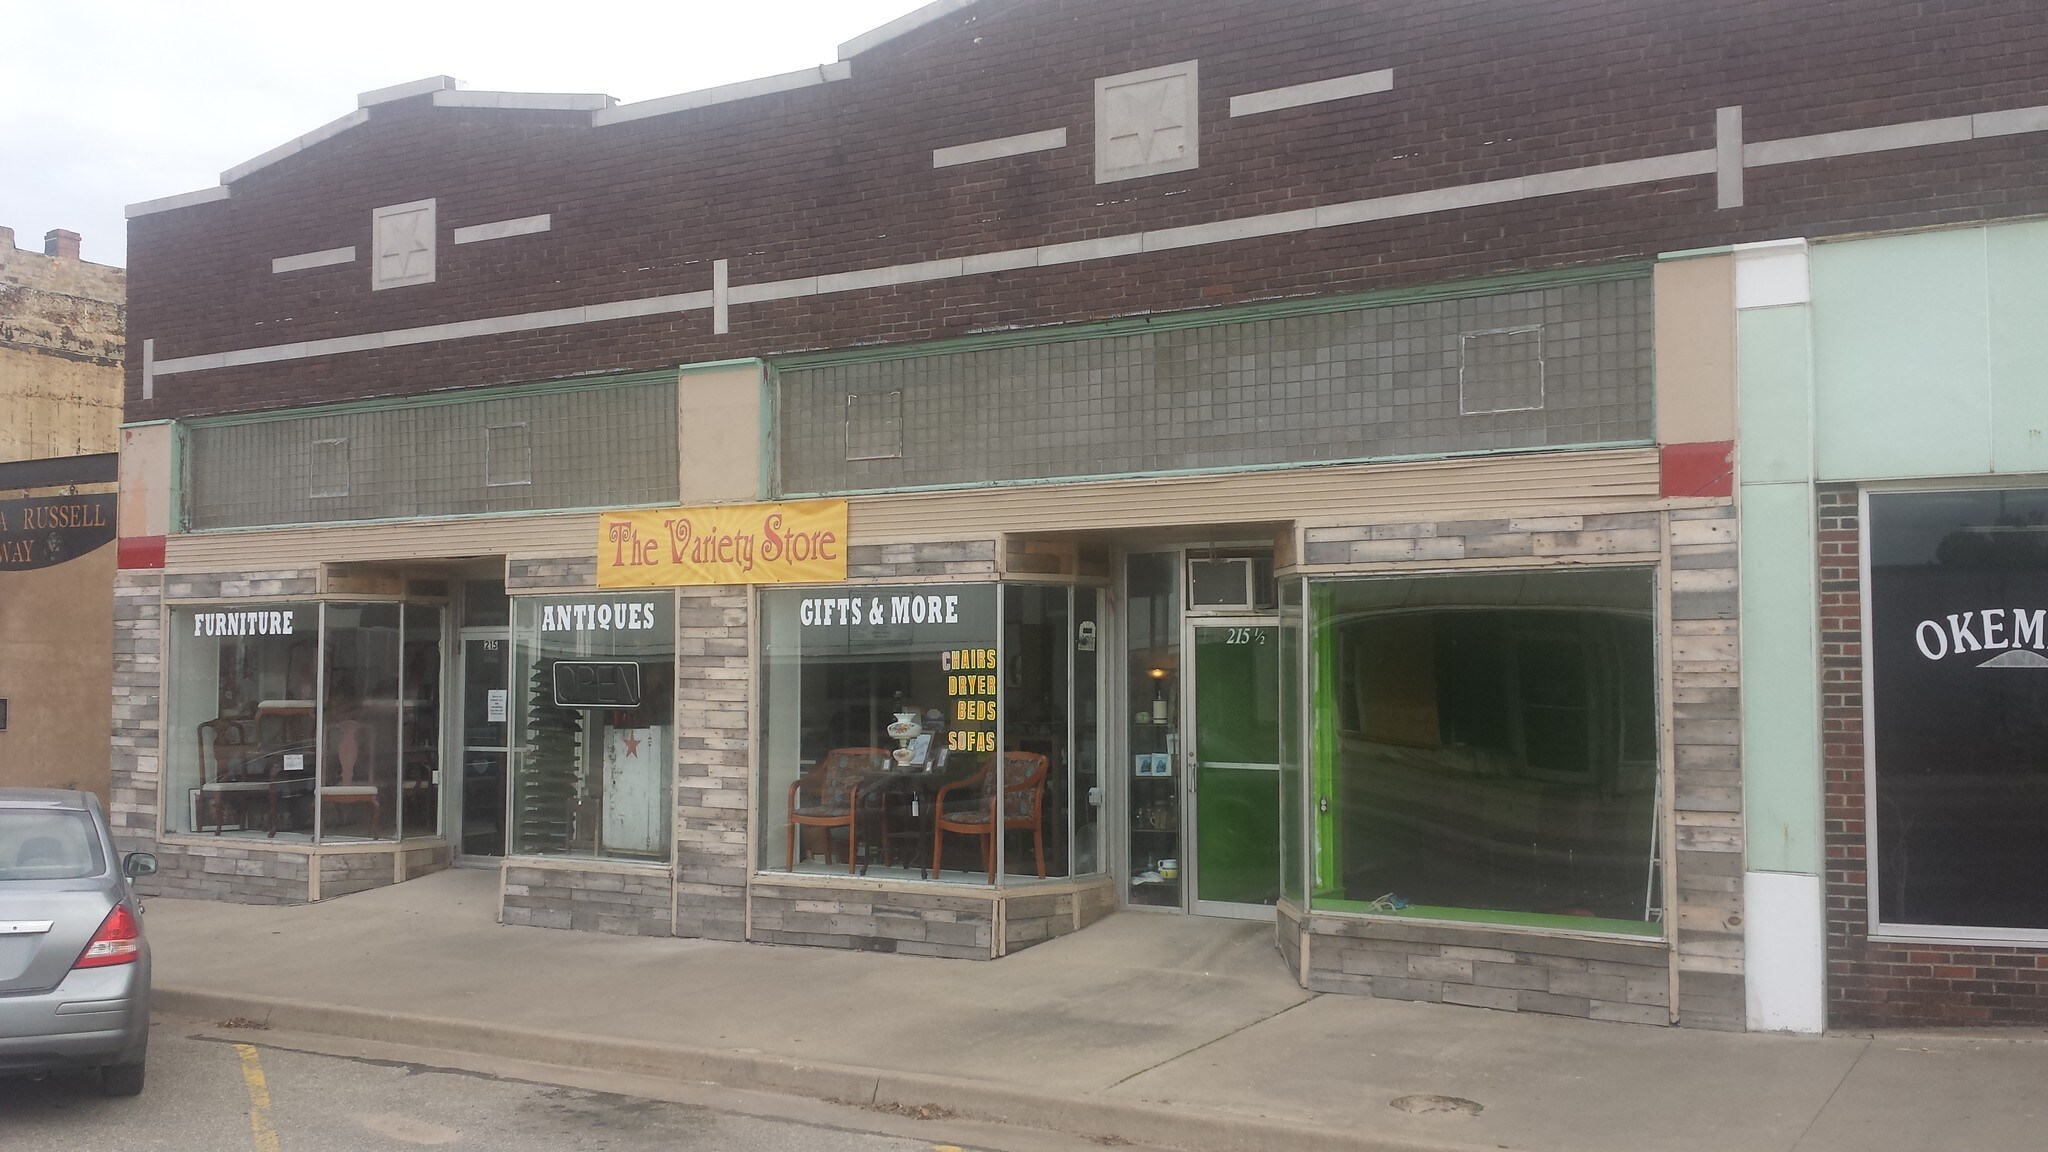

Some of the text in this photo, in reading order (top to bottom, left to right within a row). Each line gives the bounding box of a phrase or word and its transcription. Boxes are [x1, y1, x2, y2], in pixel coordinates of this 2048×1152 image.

[23, 504, 106, 530] RUSSELL
[609, 513, 837, 572] The Variety Store
[542, 602, 655, 631] ANTIQUES
[800, 595, 958, 626] GIFTS & MORE
[194, 611, 293, 637] FURNITURE
[1226, 628, 1250, 644] 215
[1915, 608, 2048, 661] OKEM
[484, 640, 498, 651] 215
[942, 649, 996, 671] CHAIRS
[556, 665, 637, 703] OPEN
[948, 675, 996, 696] DRYER
[957, 700, 996, 721] BEDS
[948, 730, 995, 752] SOFAS
